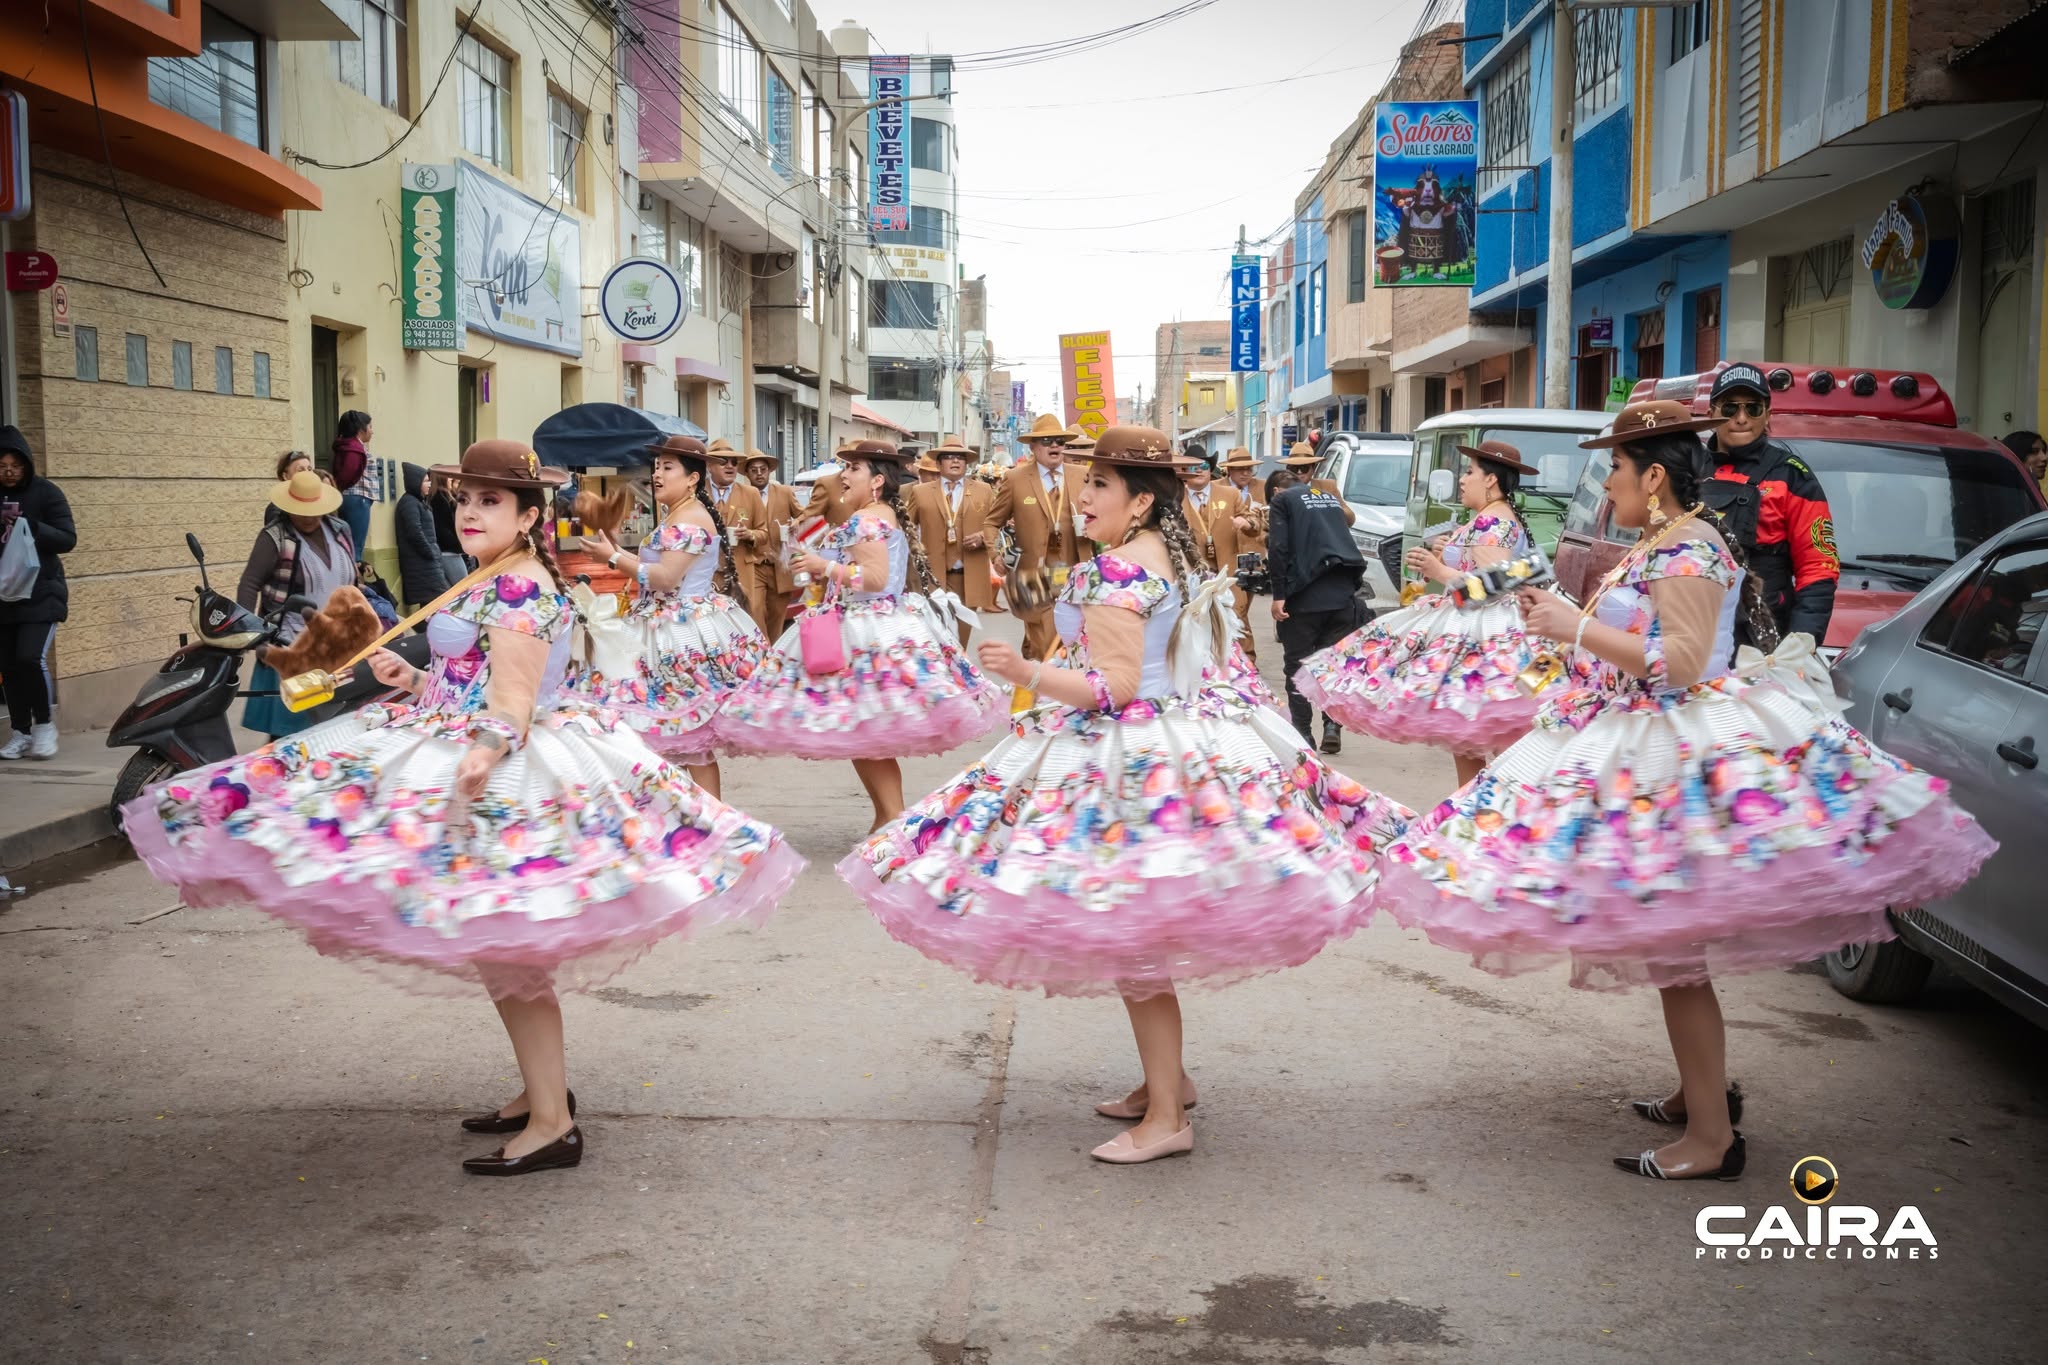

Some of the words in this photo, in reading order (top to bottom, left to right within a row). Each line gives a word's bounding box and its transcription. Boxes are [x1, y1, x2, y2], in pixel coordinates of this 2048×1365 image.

[876, 77, 903, 205] BREVETES
[1379, 114, 1473, 156] Sabores
[1404, 143, 1431, 156] VALLE
[1432, 143, 1475, 155] SAGRADO
[1862, 208, 1889, 270] Happy
[1888, 199, 1914, 260] Family
[413, 195, 443, 318] ABOGADOS
[404, 319, 455, 329] ASOCIADOS
[623, 311, 657, 330] Kenxi
[413, 330, 426, 338] 948
[441, 331, 455, 339] 829
[1062, 333, 1108, 348] BLOQUE
[1720, 366, 1761, 387] SEGURIDAD
